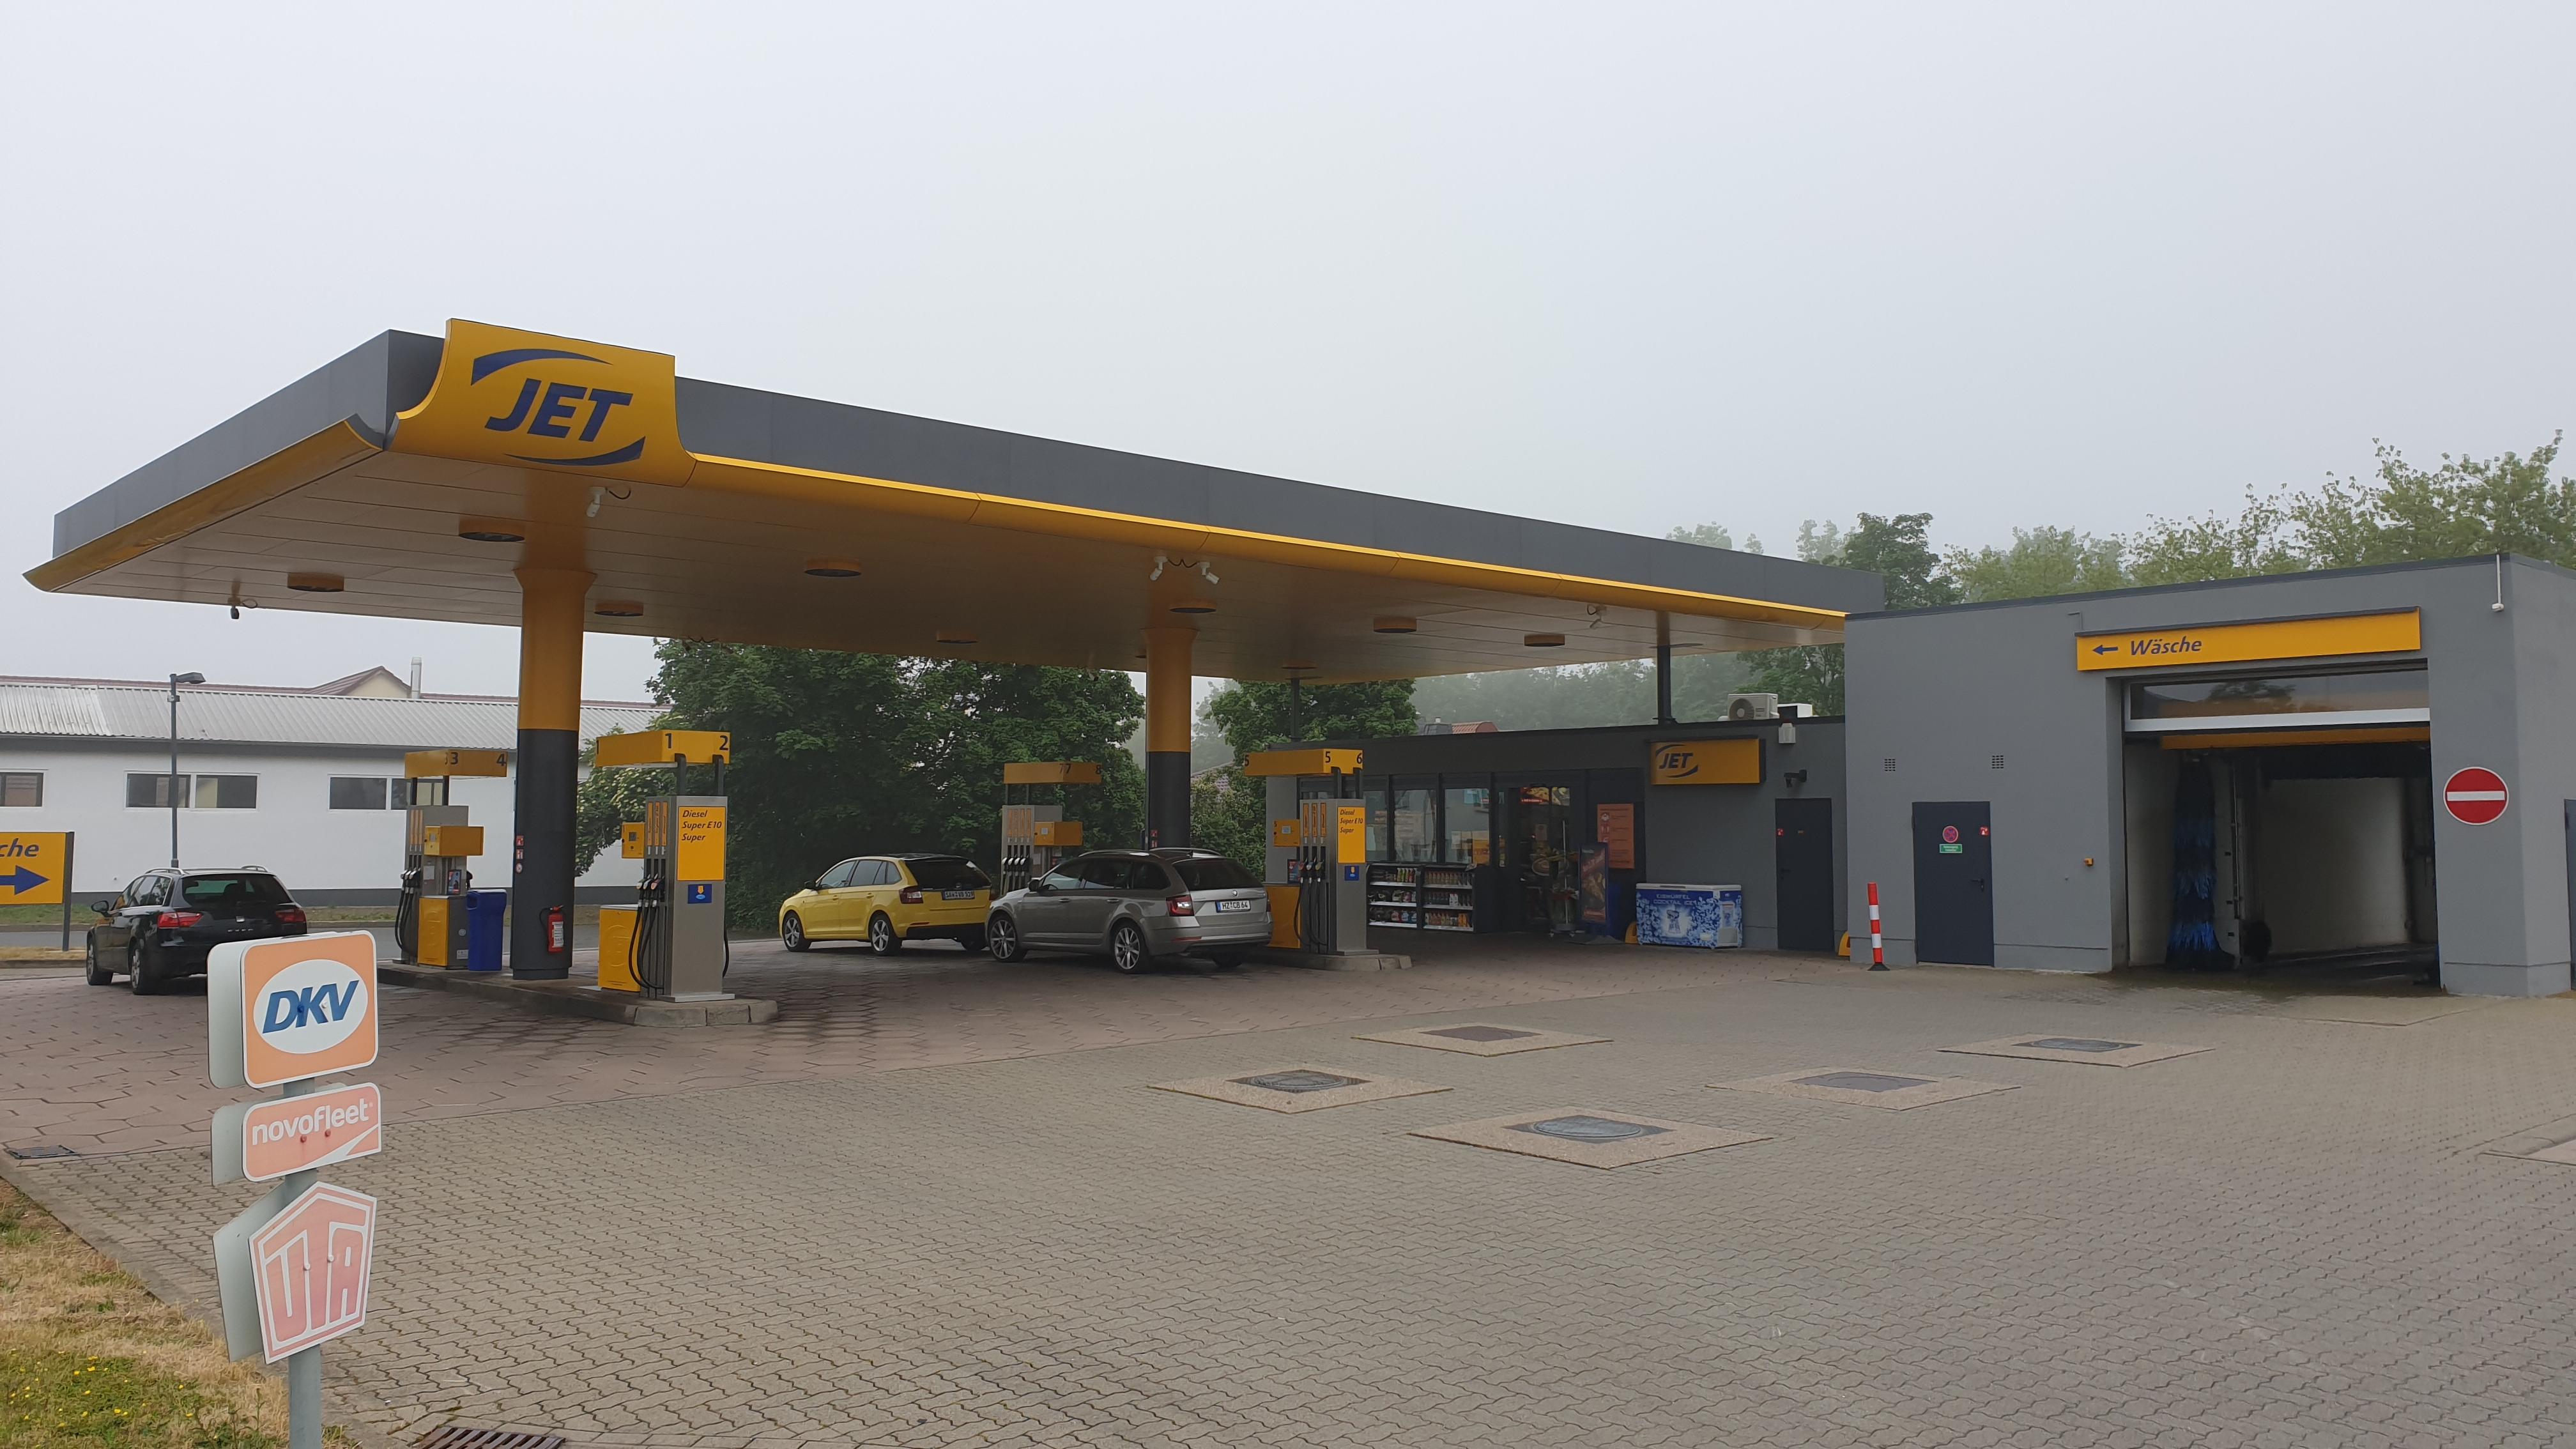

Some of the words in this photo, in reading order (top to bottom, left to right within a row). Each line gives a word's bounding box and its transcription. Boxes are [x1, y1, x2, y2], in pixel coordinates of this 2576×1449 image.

[484, 378, 634, 442] JET
[2131, 635, 2202, 656] Wäsche
[665, 733, 672, 749] 1
[719, 735, 729, 751] 2
[450, 751, 459, 765] 3
[496, 753, 507, 766] 4
[1244, 755, 1250, 766] 5
[1325, 751, 1331, 763] 5
[1356, 753, 1362, 764] 6
[1659, 753, 1694, 769] JET
[1065, 763, 1071, 774] 7
[1095, 765, 1102, 775] 8
[682, 809, 708, 818] Diesel
[682, 821, 706, 831] Super
[682, 833, 706, 843] Super
[262, 979, 360, 1034] DKV
[252, 1098, 369, 1146] novofleet
[263, 1198, 367, 1342] UTA
